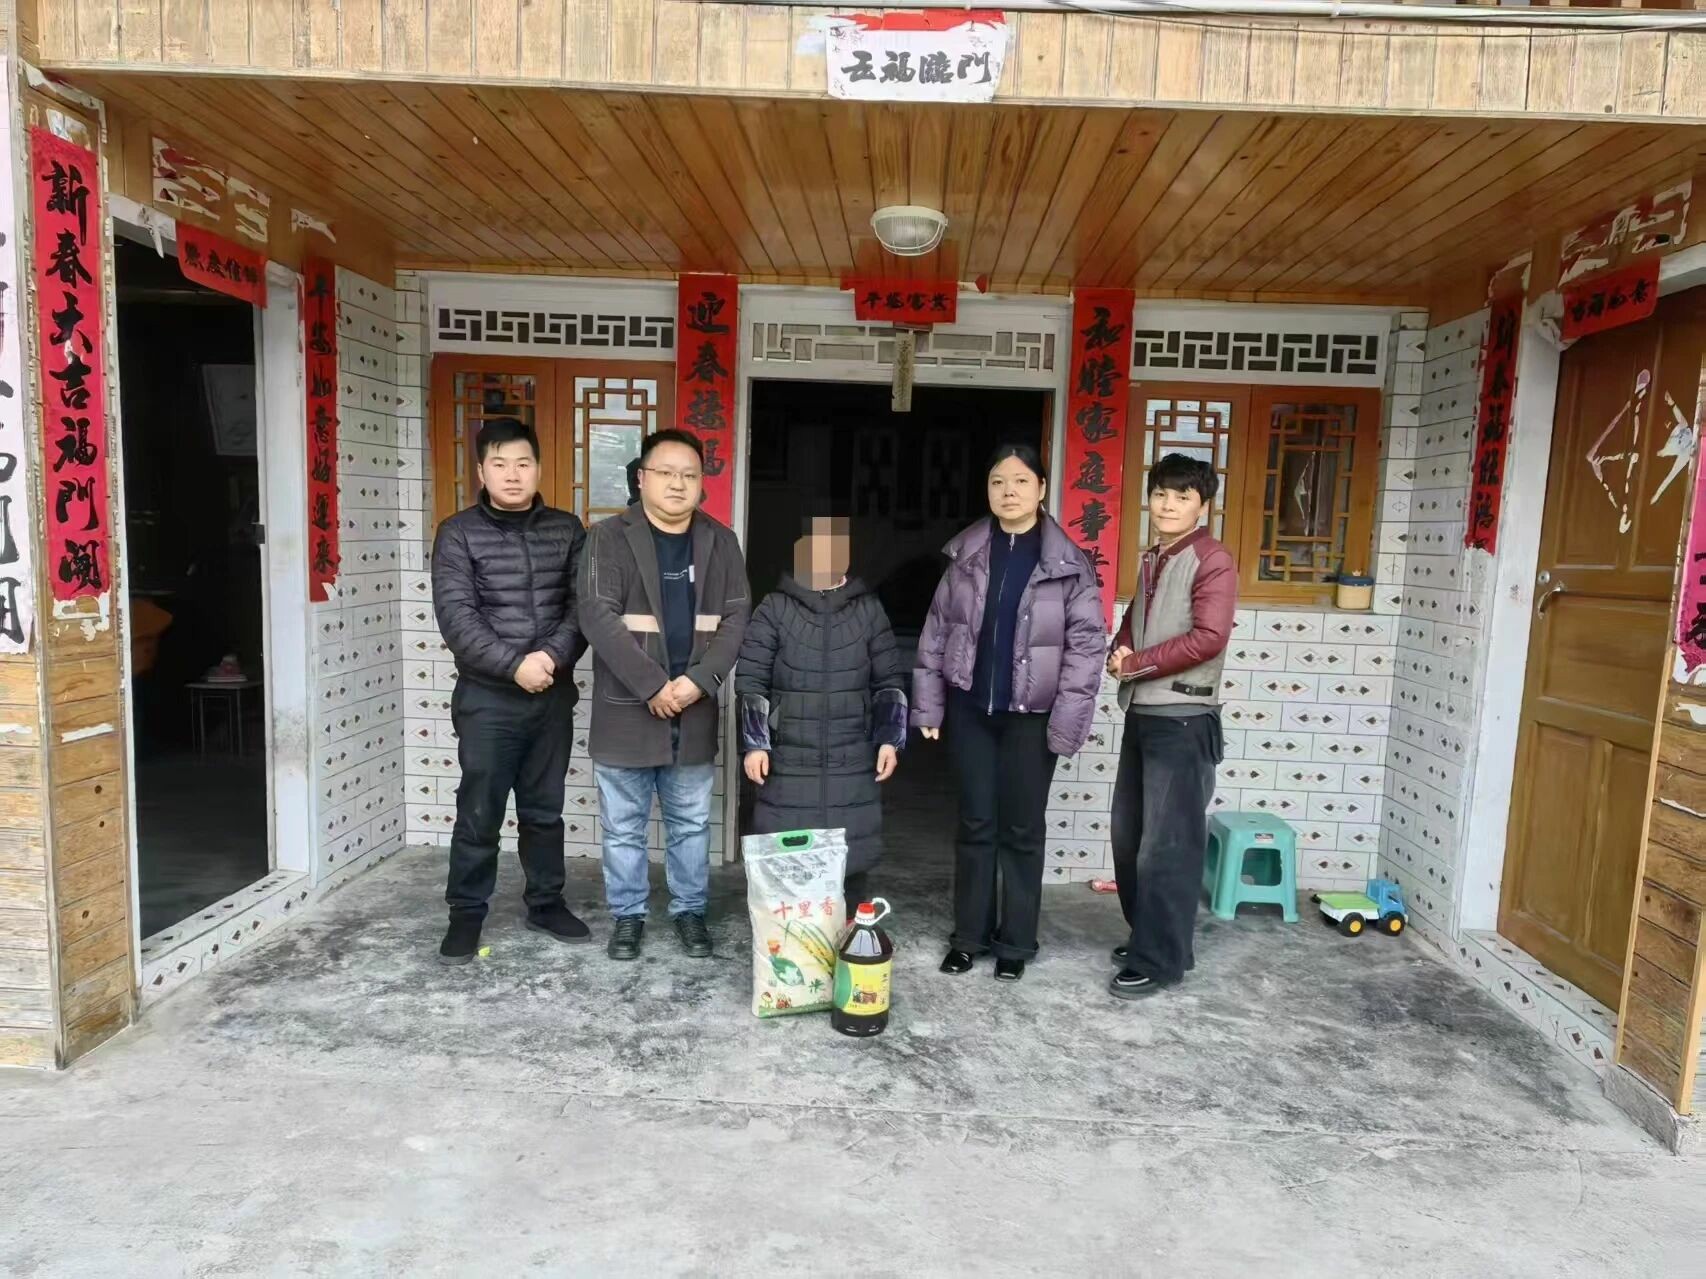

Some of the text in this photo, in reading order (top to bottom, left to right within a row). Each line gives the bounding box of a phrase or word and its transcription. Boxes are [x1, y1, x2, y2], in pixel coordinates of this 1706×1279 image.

[772, 896, 836, 920] 十里香
[809, 979, 825, 993] 米
